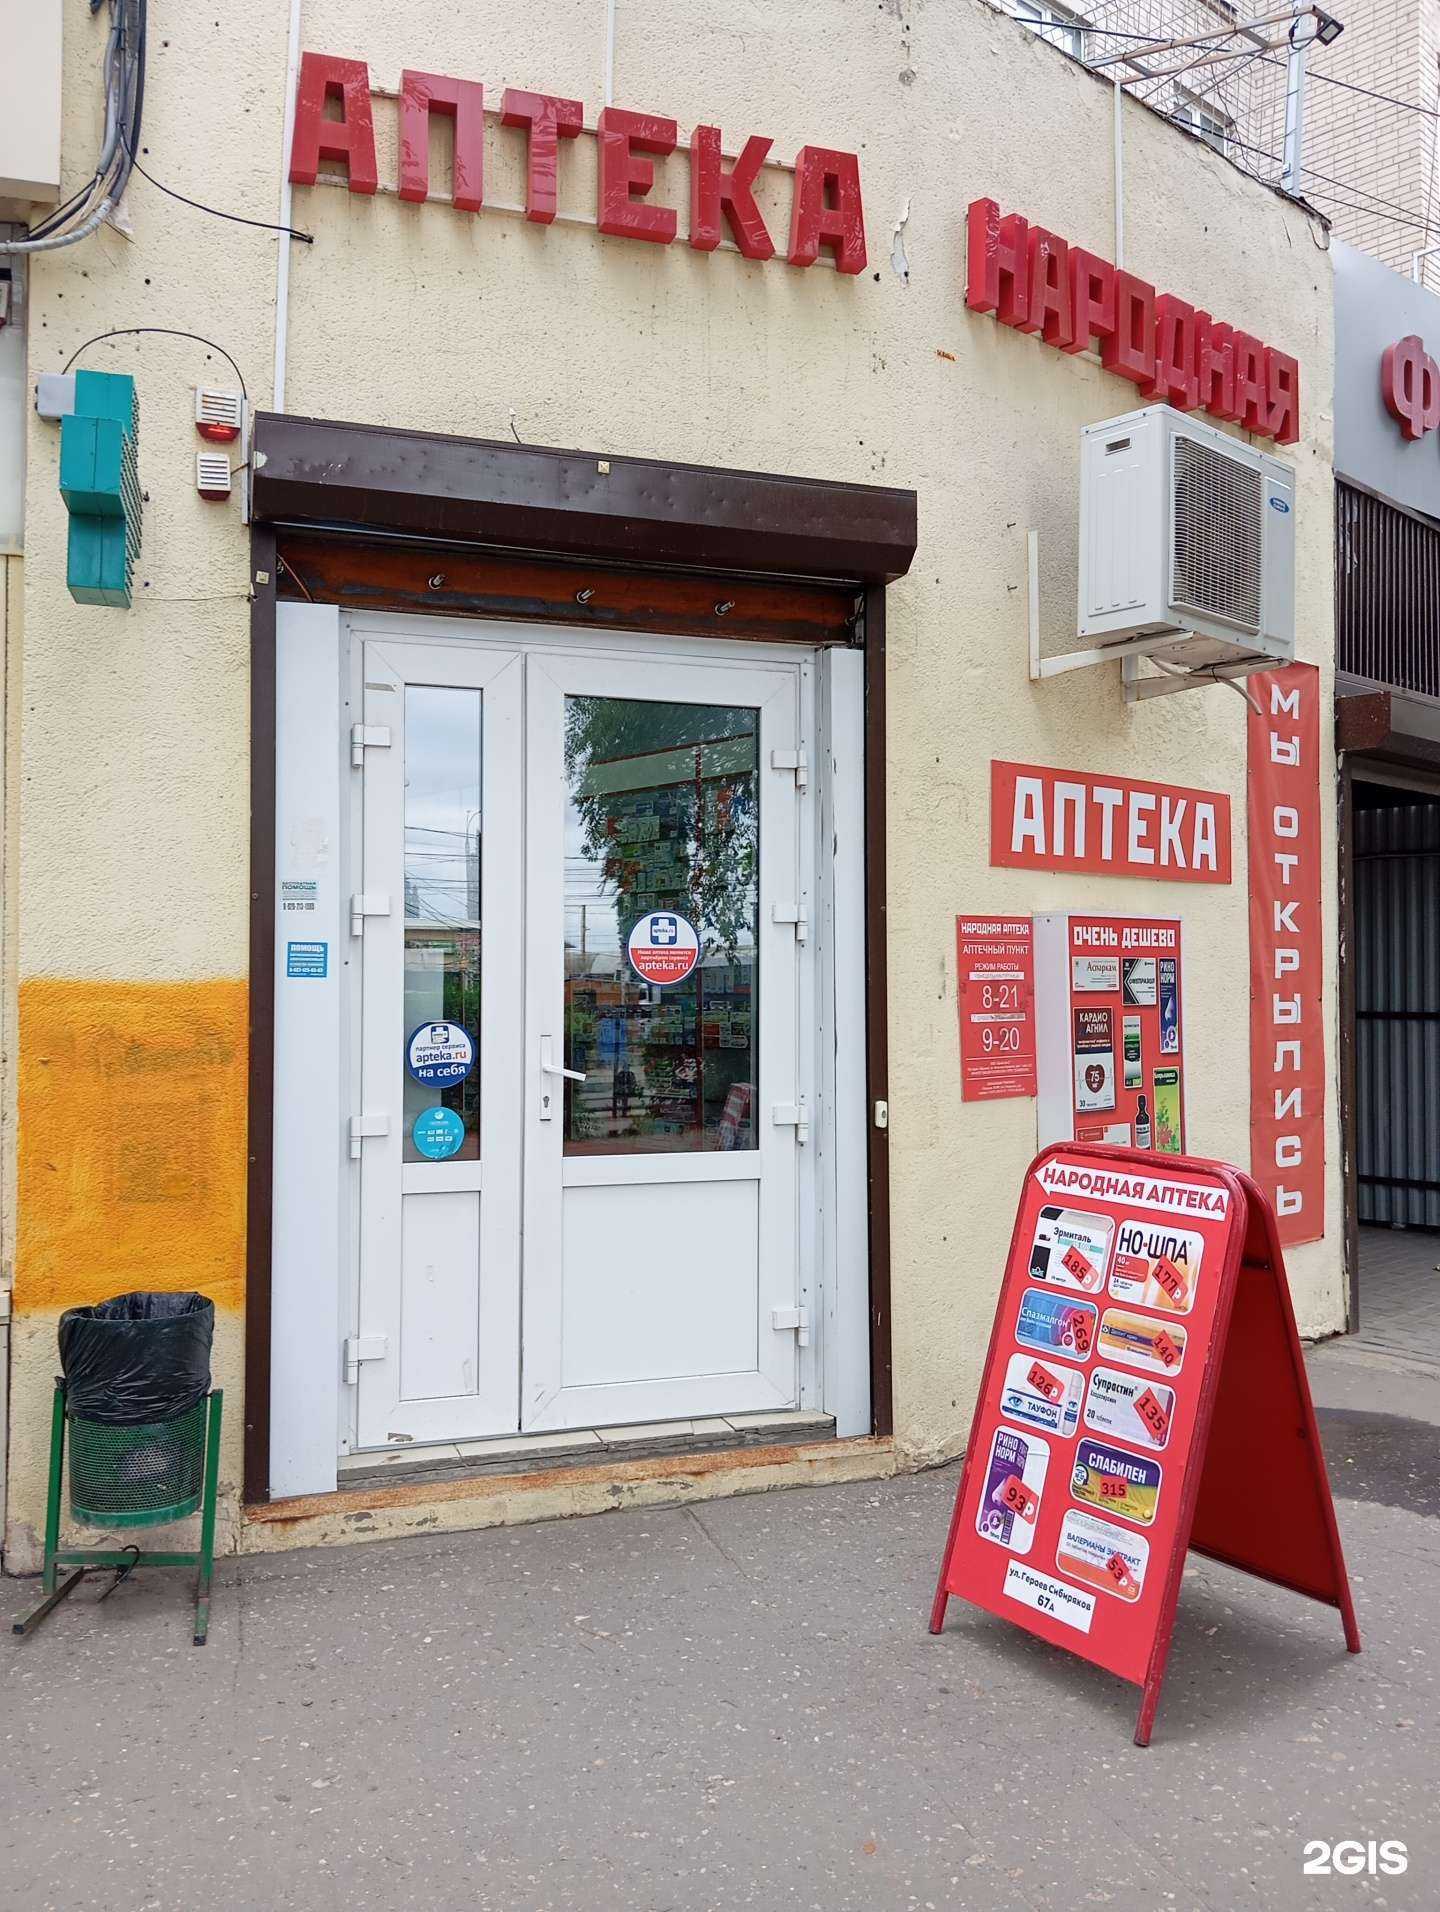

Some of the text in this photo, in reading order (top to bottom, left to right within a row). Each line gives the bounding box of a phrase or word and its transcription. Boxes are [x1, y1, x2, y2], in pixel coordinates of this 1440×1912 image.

[289, 51, 867, 275] АПТЕКА
[967, 197, 1299, 446] НАРОДНАЯ
[1011, 775, 1218, 872] АПТЕКА
[961, 922, 1030, 935] НАРОДНАЯ АПТЕКА
[1073, 926, 1176, 949] ОЧЕНЬ ДЕШЕВО
[962, 943, 1029, 955] АПТЕЧНЫЙ ПУНКТ
[1269, 683, 1303, 1217] МЫ ОТКРЫЛИСЬ
[638, 960, 689, 971] apteka.ru
[974, 962, 1019, 971] РЕЖИМ РАБОТЫ
[1087, 961, 1117, 973] Аспаркам
[1159, 961, 1176, 973] РИНО
[982, 984, 1018, 1009] 8-21
[1079, 1011, 1108, 1023] КАРДИО
[982, 1027, 1020, 1052] 9-20
[1085, 1023, 1109, 1034] АГНИЛ
[416, 1050, 467, 1064] apteka.ru
[418, 1063, 466, 1078] на себя
[1089, 1070, 1100, 1082] 75
[1043, 1167, 1226, 1214] НАРОДНАЯ АПТЕКА
[1053, 1226, 1092, 1243] Эрмиталь
[1063, 1254, 1087, 1279] 185
[1155, 1265, 1178, 1293] 177
[1021, 1306, 1069, 1328] Спазмалгон
[1072, 1314, 1090, 1351] 269
[1154, 1337, 1174, 1364] 140
[1029, 1370, 1053, 1395] 126
[1092, 1373, 1135, 1398] Супрастин
[1027, 1401, 1058, 1419] ТАУФОН
[1086, 1408, 1096, 1419] 20
[1138, 1397, 1166, 1431] 135
[997, 1432, 1019, 1451] РИНО
[994, 1444, 1017, 1463] НОРМ
[1088, 1452, 1147, 1484] СЛАБИЛЕН
[1006, 1486, 1026, 1511] 93
[1101, 1482, 1126, 1497] 315
[1066, 1532, 1106, 1554] ВАЛЕРИАНЫ
[1106, 1547, 1142, 1567] ЭКТРАКТ
[1108, 1558, 1123, 1579] 53
[1009, 1567, 1091, 1611] ул. Героев Сибиряков
